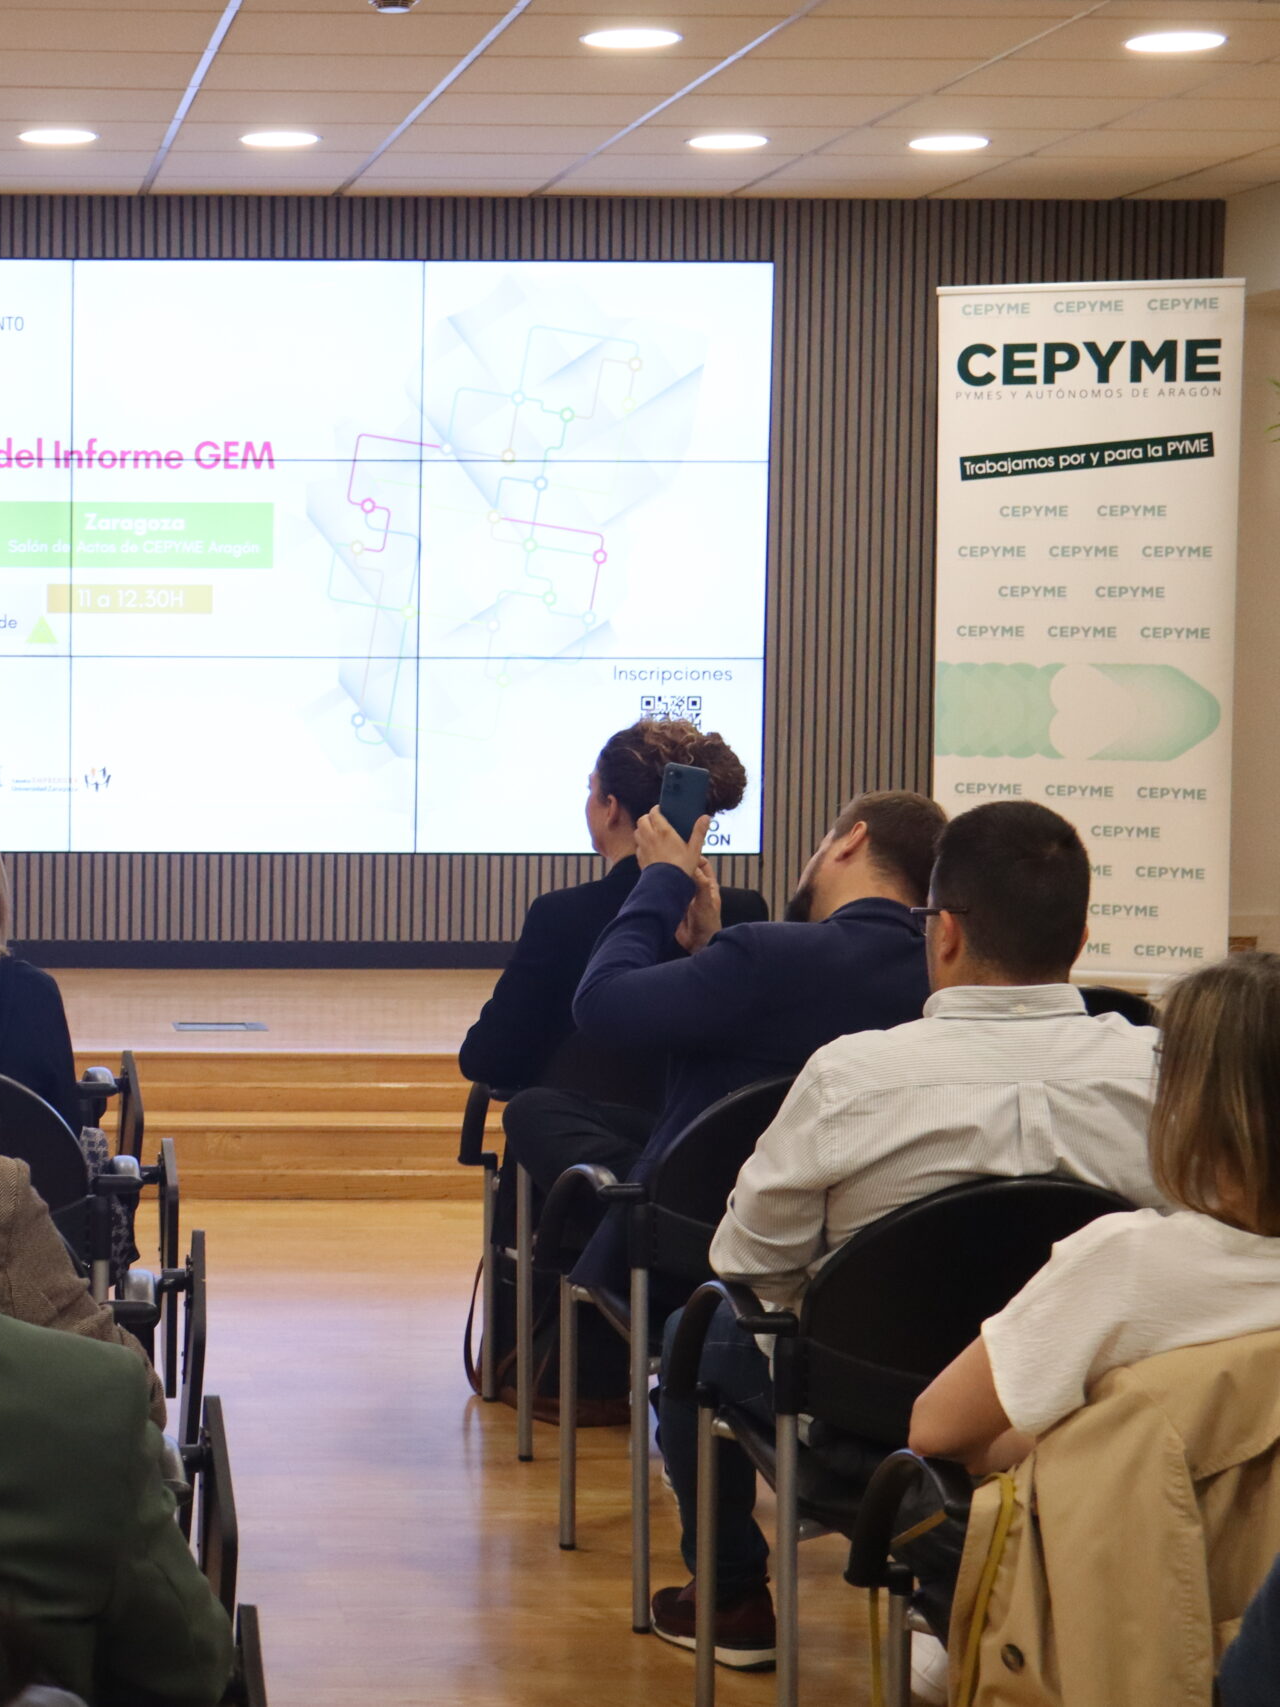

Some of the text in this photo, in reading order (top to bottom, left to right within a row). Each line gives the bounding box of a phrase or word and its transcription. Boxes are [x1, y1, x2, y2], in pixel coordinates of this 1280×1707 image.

[961, 302, 1030, 316] CEPYME
[1053, 300, 1123, 314] CEPYME
[1147, 297, 1219, 312] CEPYME
[957, 338, 1222, 386] CEPYME
[956, 386, 1222, 401] PYMES Y AUTÓNOMOS DE ARAGÓN
[54, 438, 184, 469] Informe
[194, 440, 275, 470] GEM
[964, 438, 1210, 477] Trabajamos por y para la PYME
[999, 505, 1069, 518] CEPYME
[1097, 504, 1167, 518] CEPYME
[84, 512, 186, 536] Zaragoza
[7, 539, 261, 558] Salón de Actos de CEPYME Aragón
[958, 545, 1026, 558] CEPYME
[1049, 545, 1119, 558] CEPYME
[1141, 545, 1213, 559] CEPYME
[78, 589, 91, 608] 11
[97, 594, 111, 608] a
[998, 585, 1068, 598] CEPYME
[1095, 585, 1165, 599] CEPYME
[956, 625, 1025, 638] CEPYME
[1047, 625, 1117, 639] CEPYME
[1140, 626, 1211, 640] CEPYME
[613, 665, 733, 685] Inscripciones
[954, 782, 1023, 796] CEPYME
[1044, 784, 1114, 798] CEPYME
[1136, 786, 1207, 801] CEPYME
[1090, 824, 1160, 839] CEPYME
[1135, 866, 1205, 880] CEPYME
[1089, 903, 1159, 918] CEPYME
[1133, 944, 1204, 959] CEPYME
